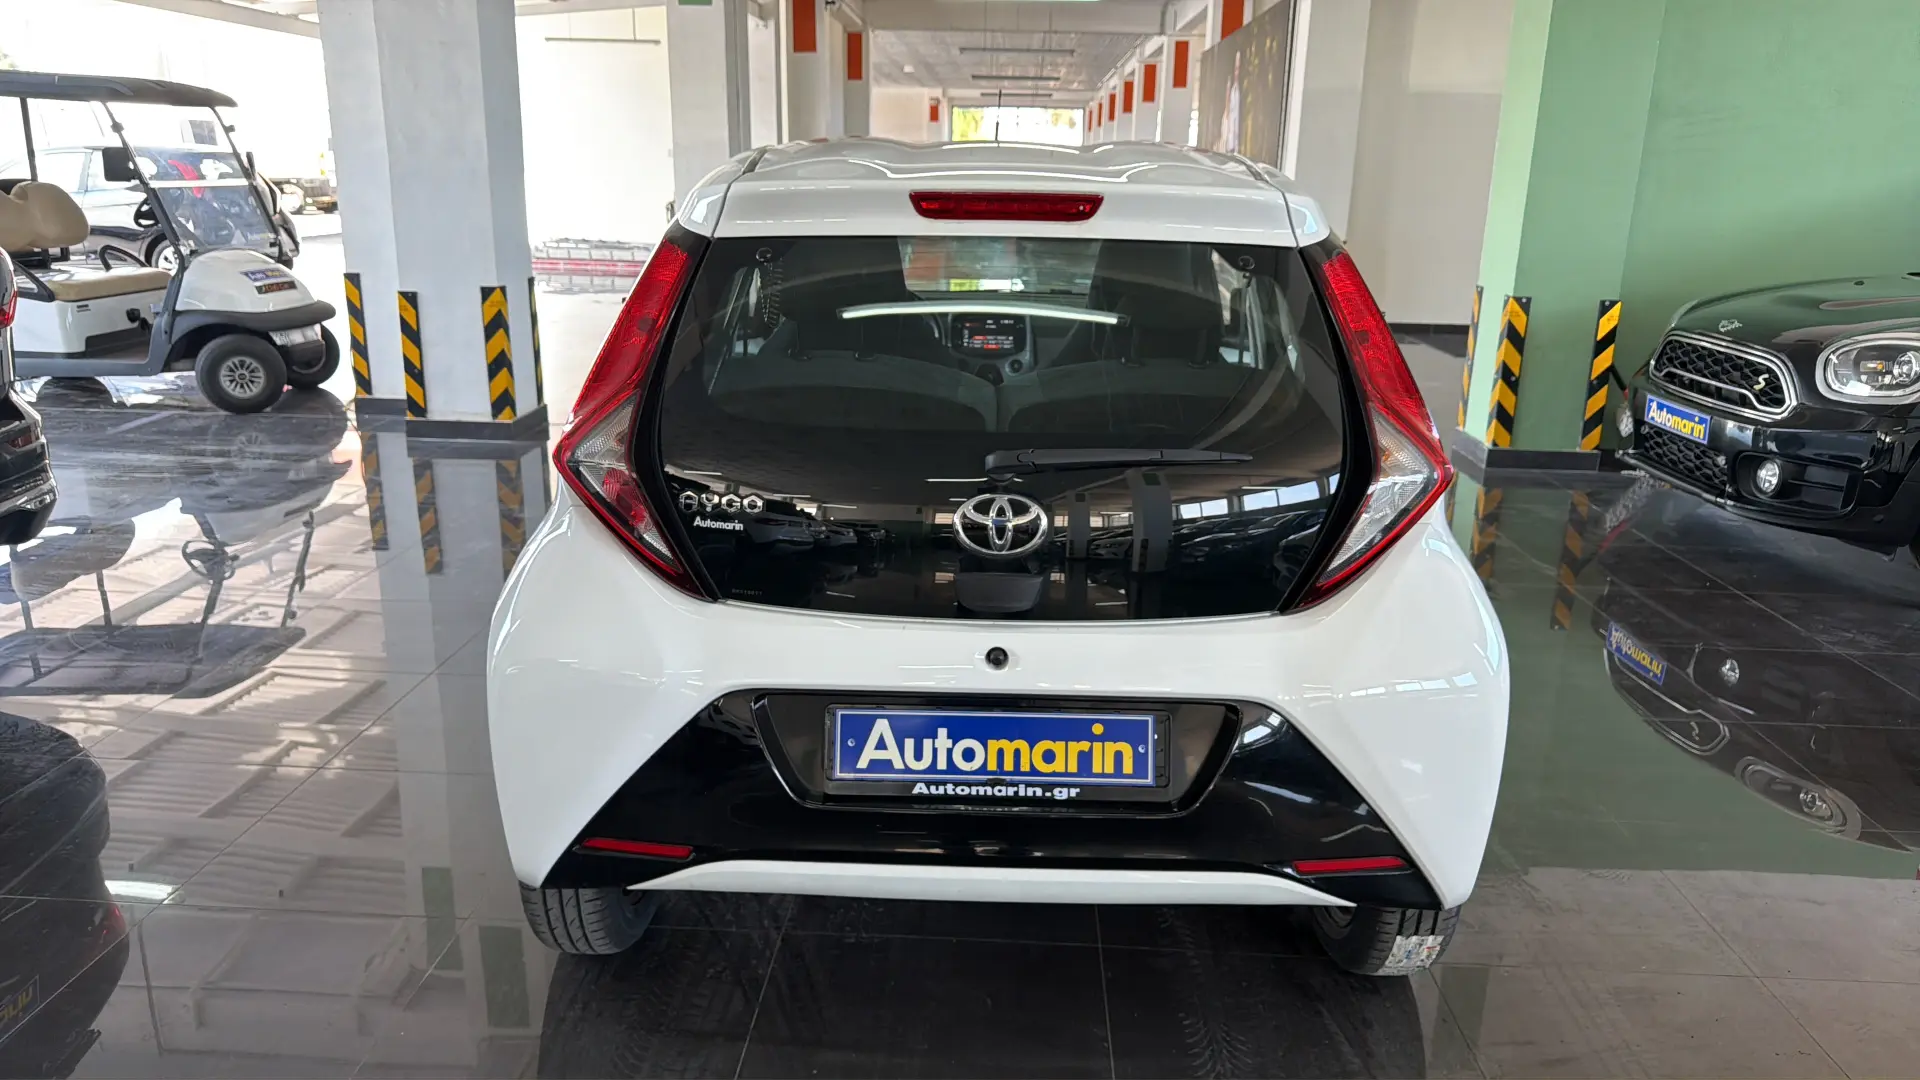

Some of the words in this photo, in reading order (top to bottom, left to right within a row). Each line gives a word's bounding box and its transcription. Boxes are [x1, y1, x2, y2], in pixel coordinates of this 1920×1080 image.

[1648, 400, 1705, 439] Automarin
[679, 490, 764, 515] AYGO
[693, 516, 744, 531] Automarin
[856, 718, 1133, 774] Automarin
[911, 782, 1081, 799] Automarin.gr
